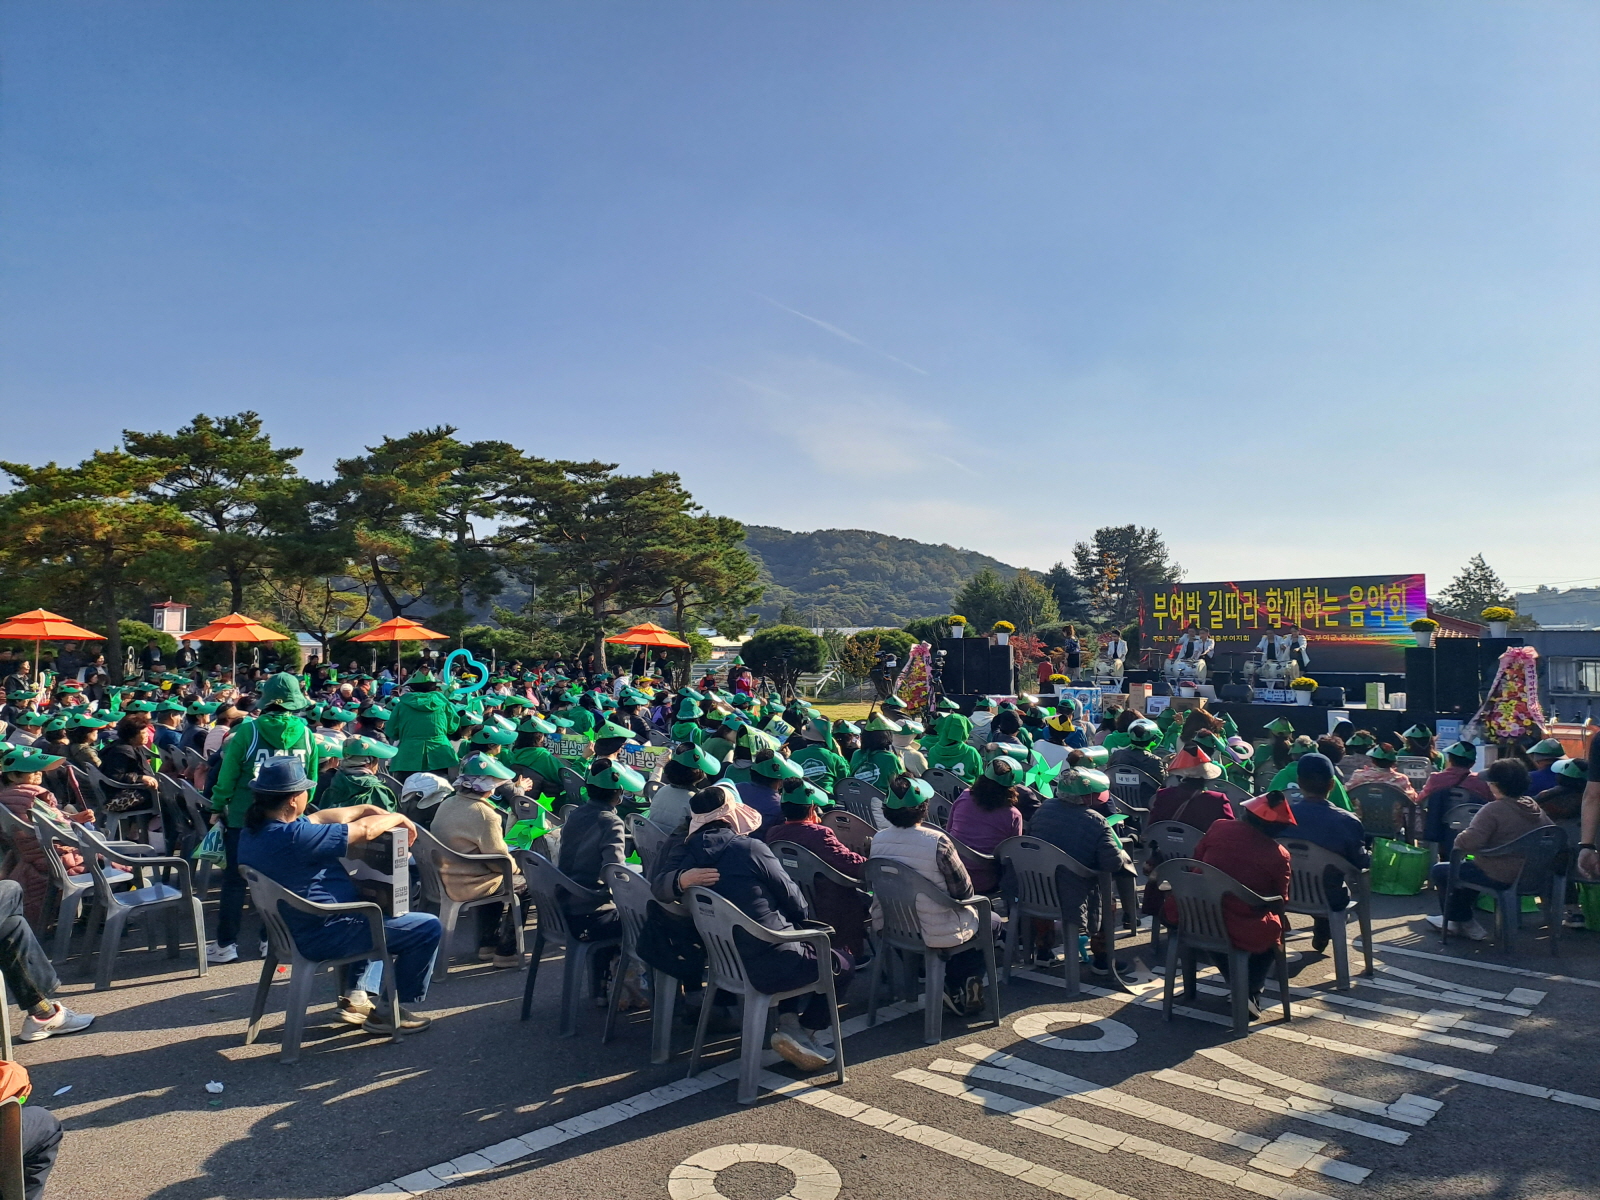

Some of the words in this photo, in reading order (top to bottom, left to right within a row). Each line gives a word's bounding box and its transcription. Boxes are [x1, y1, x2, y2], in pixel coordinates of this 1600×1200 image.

[1153, 590, 1202, 630] 부여밤
[1208, 589, 1260, 629] 길따라
[1265, 584, 1341, 629] 함께하는
[1347, 583, 1408, 627] 음악회
